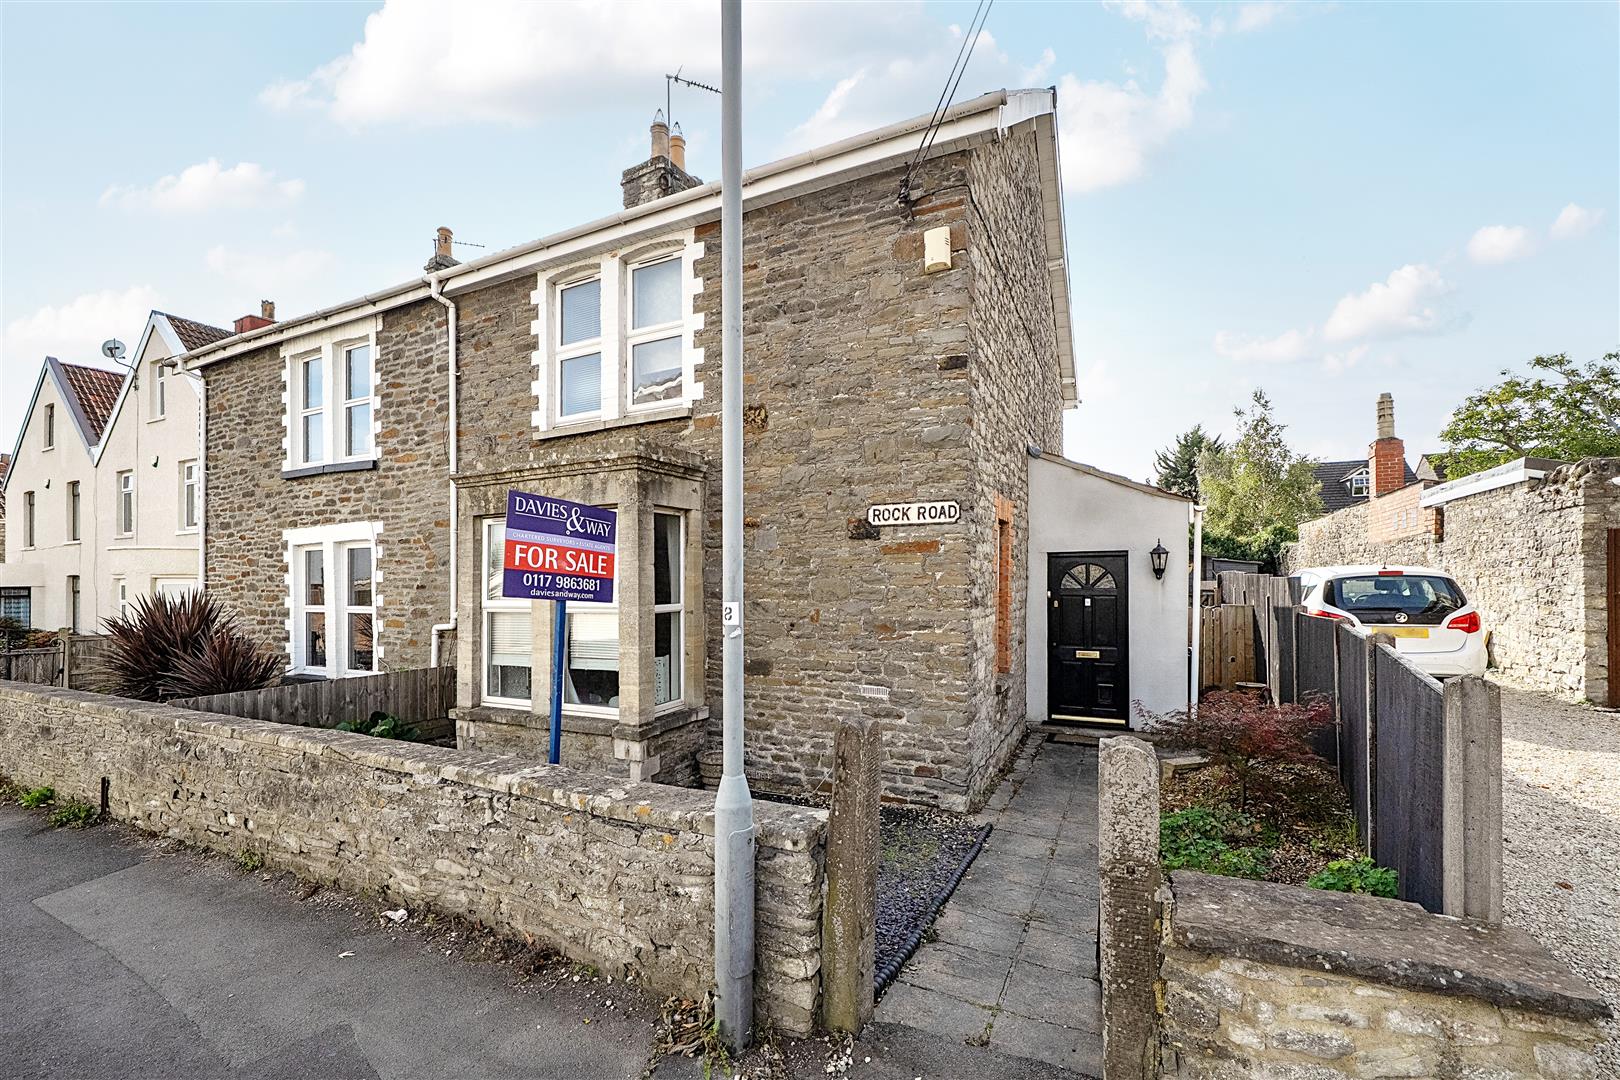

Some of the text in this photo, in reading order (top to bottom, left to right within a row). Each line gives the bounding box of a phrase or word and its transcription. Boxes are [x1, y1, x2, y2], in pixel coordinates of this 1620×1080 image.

[515, 497, 611, 537] DAVIES & WAY
[872, 505, 958, 522] ROCK ROAD
[512, 532, 545, 541] CHARTERED
[545, 537, 575, 545] SURVEYORS
[515, 544, 608, 575] FOR SALE
[523, 573, 600, 591] 0117 9863681
[530, 588, 594, 599] daviesandway.com
